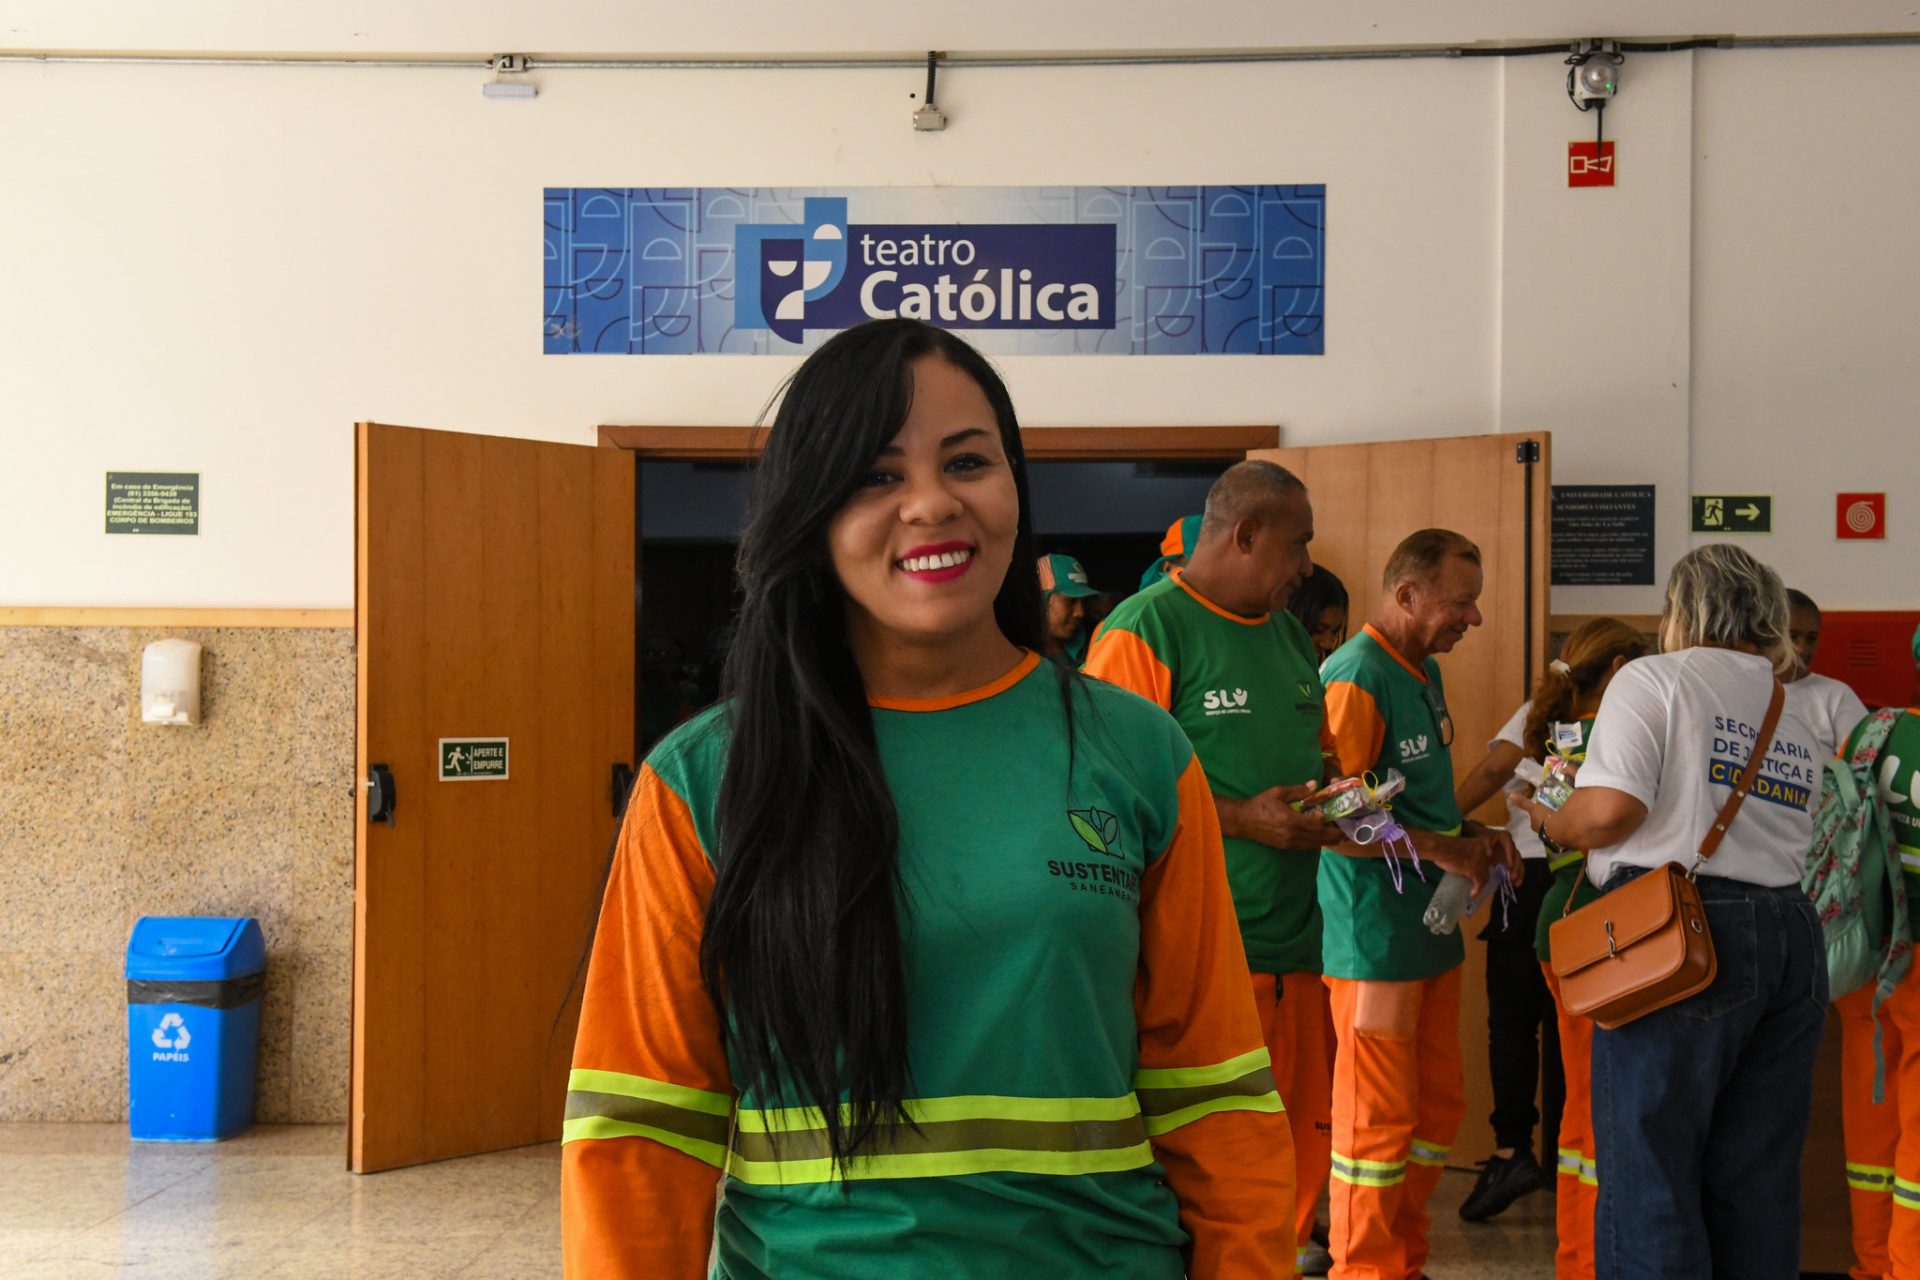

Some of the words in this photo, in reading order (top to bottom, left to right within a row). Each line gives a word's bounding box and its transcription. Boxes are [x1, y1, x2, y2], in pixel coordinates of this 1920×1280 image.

[860, 233, 975, 266] teatro
[859, 268, 1100, 321] Católica
[149, 517, 195, 525] BOMBEIROS
[1715, 716, 1812, 762] SECRARIA
[473, 747, 498, 757] APERTE
[498, 747, 504, 757] E
[1713, 737, 1740, 758] DE
[1743, 746, 1802, 780] JTIÇA
[1806, 768, 1814, 784] E
[473, 760, 503, 770] EMPURRE
[152, 1048, 190, 1062] PAPÉIS
